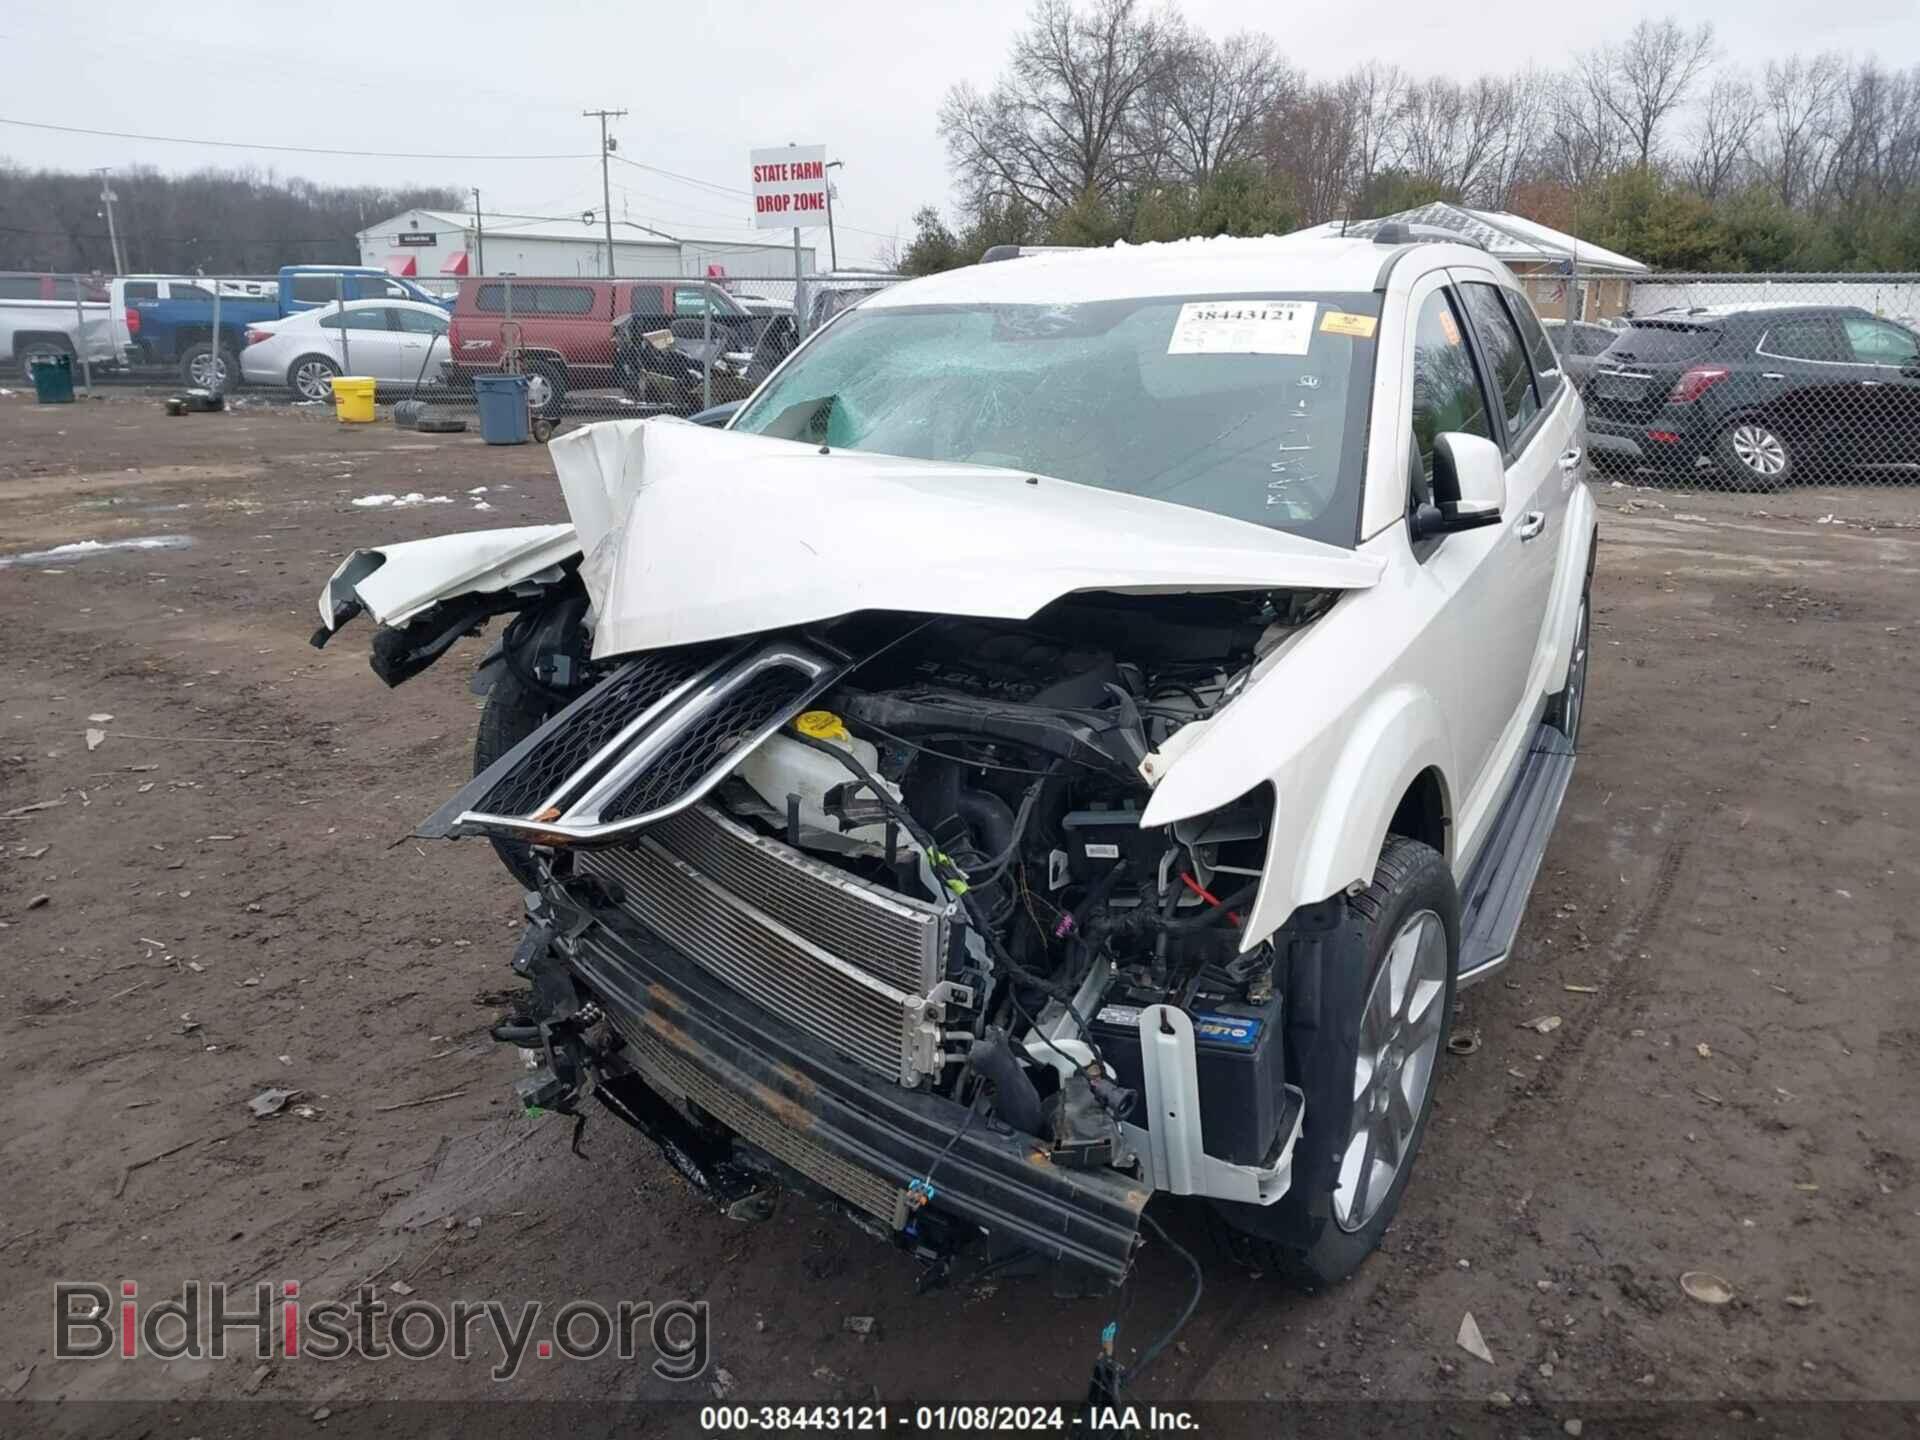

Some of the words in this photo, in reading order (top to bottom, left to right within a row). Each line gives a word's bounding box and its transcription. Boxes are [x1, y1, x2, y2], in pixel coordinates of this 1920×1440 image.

[754, 163, 788, 183] STATE
[790, 161, 824, 181] FARM
[756, 194, 790, 213] DROP
[793, 192, 825, 211] ZONE
[1191, 310, 1295, 321] 38443121
